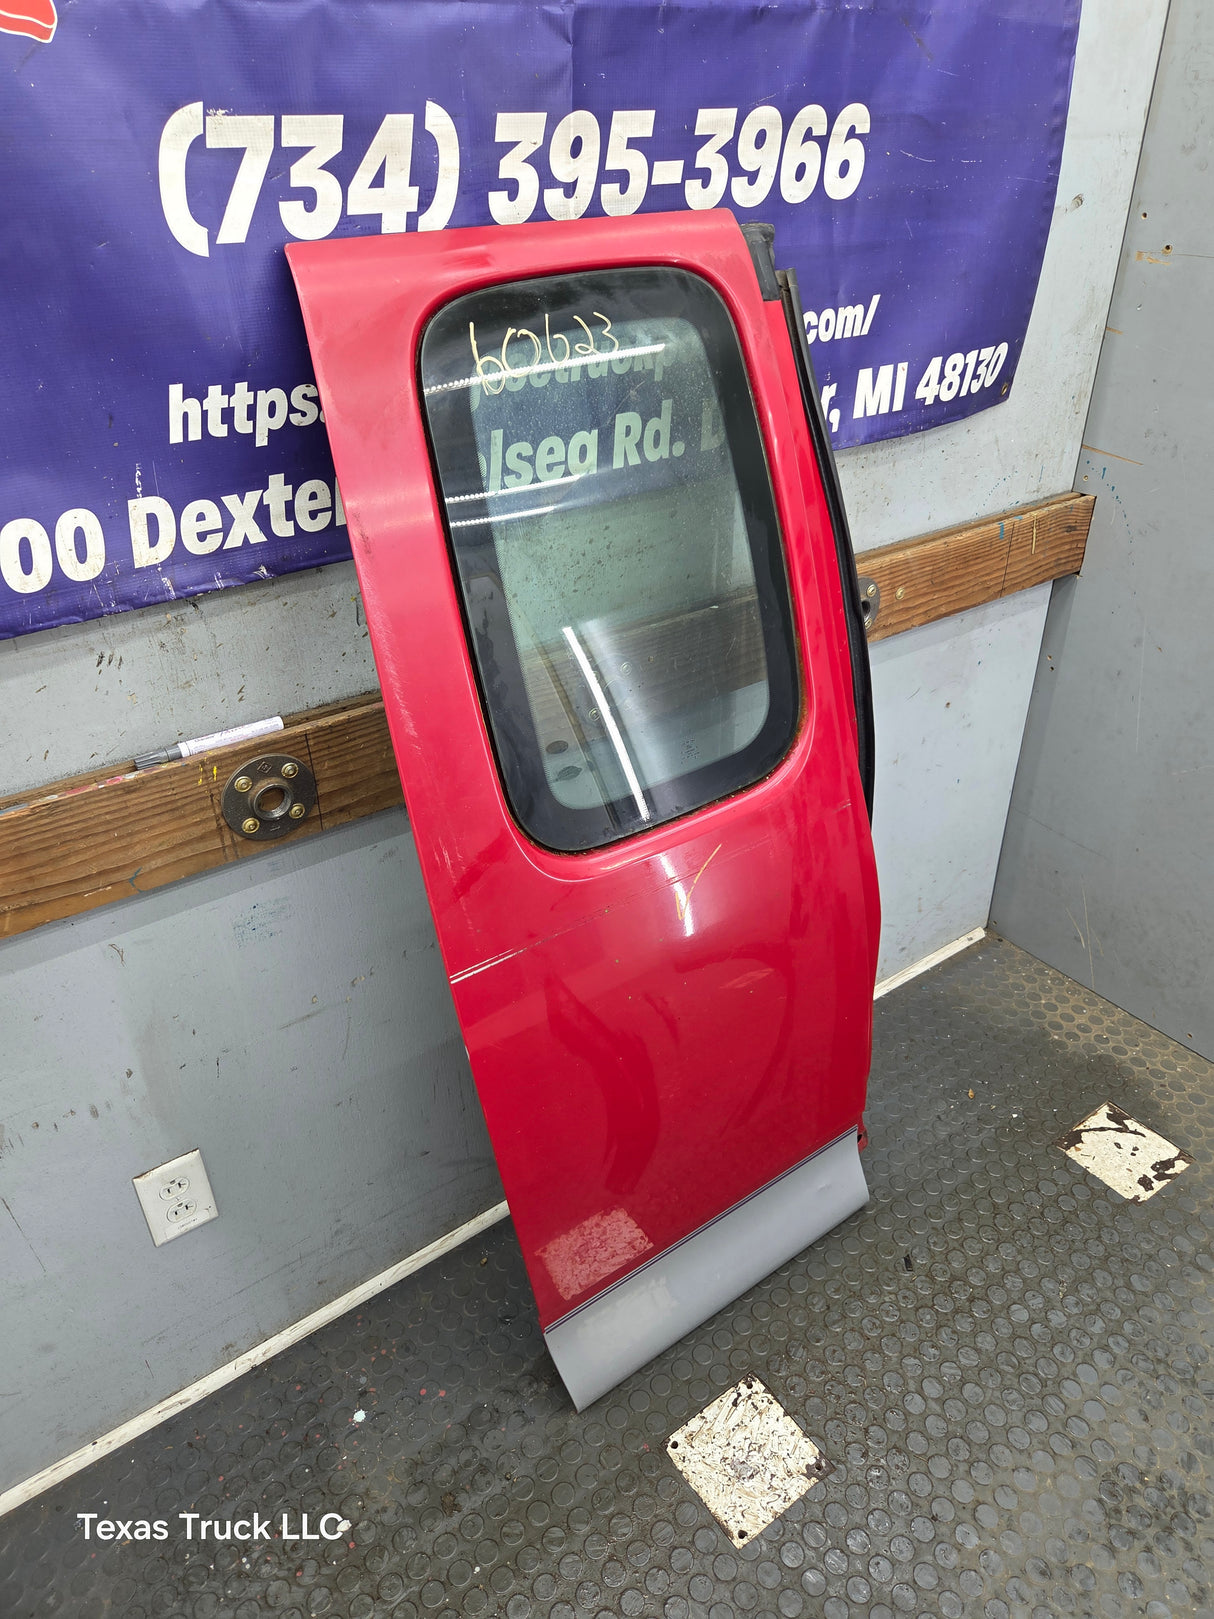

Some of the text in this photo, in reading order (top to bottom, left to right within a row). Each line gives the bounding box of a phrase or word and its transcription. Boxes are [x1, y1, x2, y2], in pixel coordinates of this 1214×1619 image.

[158, 100, 871, 257] (734) 395-3966
[0, 508, 105, 594] 00
[479, 428, 598, 492] lsea
[613, 399, 686, 469] Rd.
[853, 362, 908, 419] MI
[915, 342, 1008, 406] 48130
[169, 381, 325, 448] https
